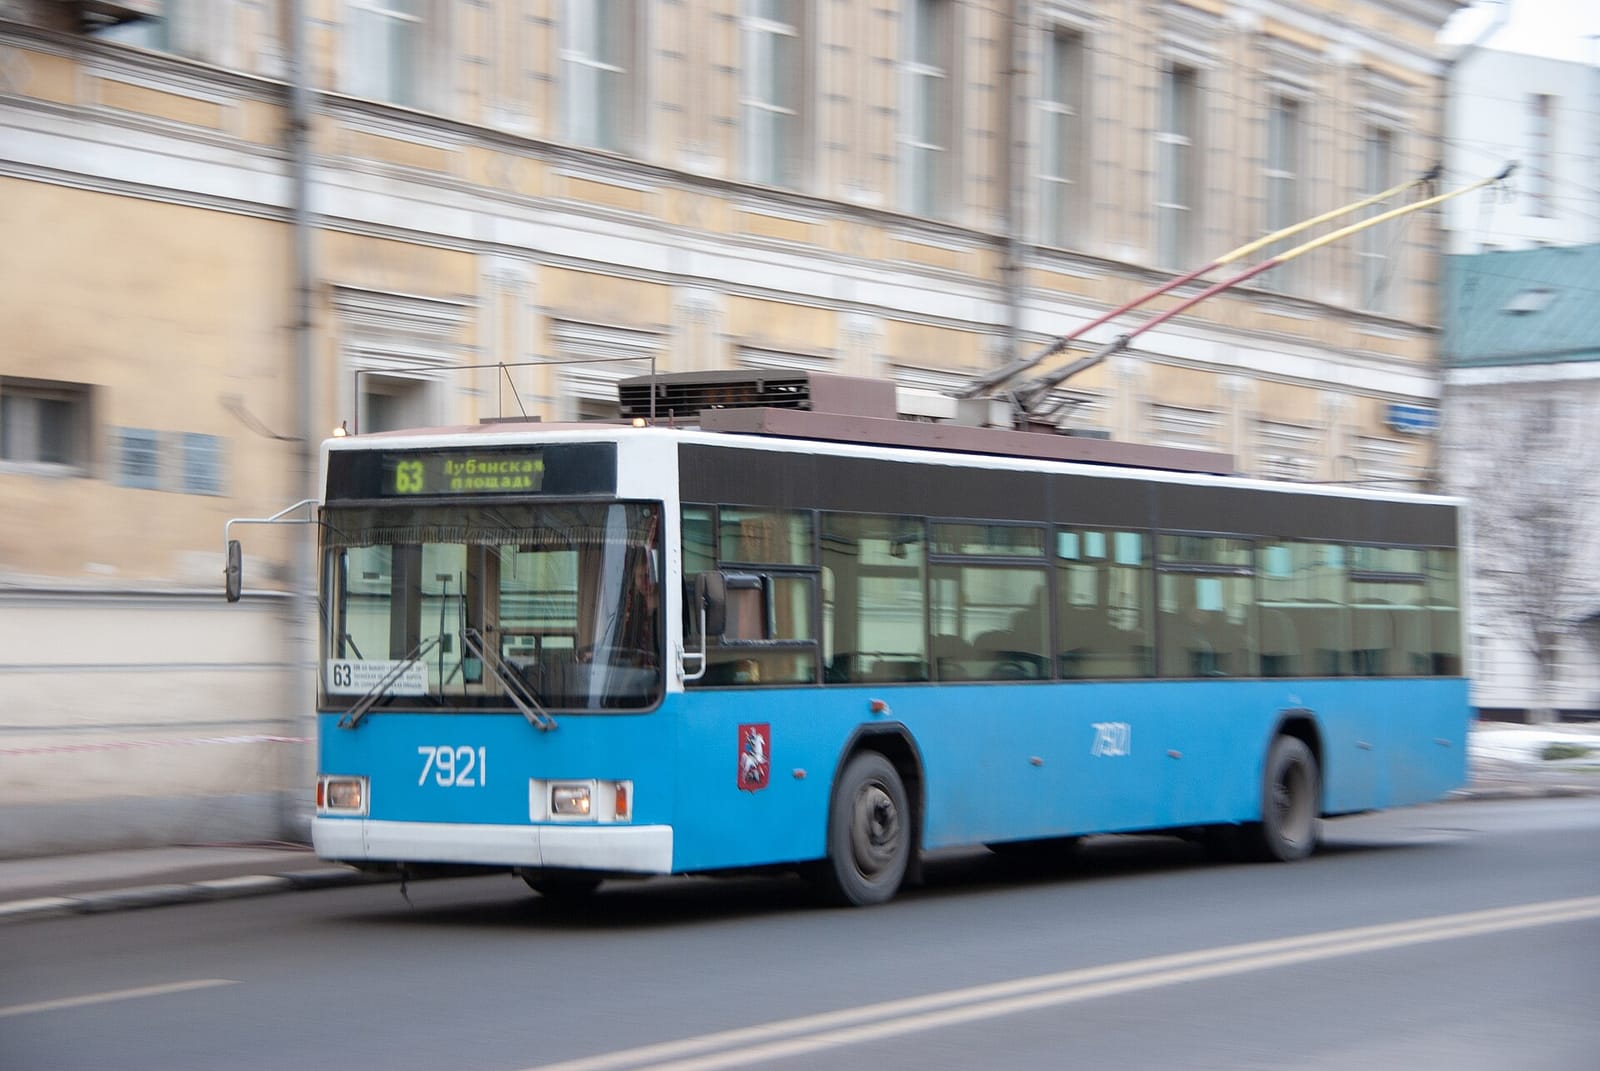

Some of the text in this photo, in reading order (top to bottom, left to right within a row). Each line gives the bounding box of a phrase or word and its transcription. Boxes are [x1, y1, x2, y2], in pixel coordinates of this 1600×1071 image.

[396, 460, 424, 492] 63
[450, 475, 532, 489] площадь
[333, 664, 352, 687] 63
[418, 745, 486, 787] 7921
